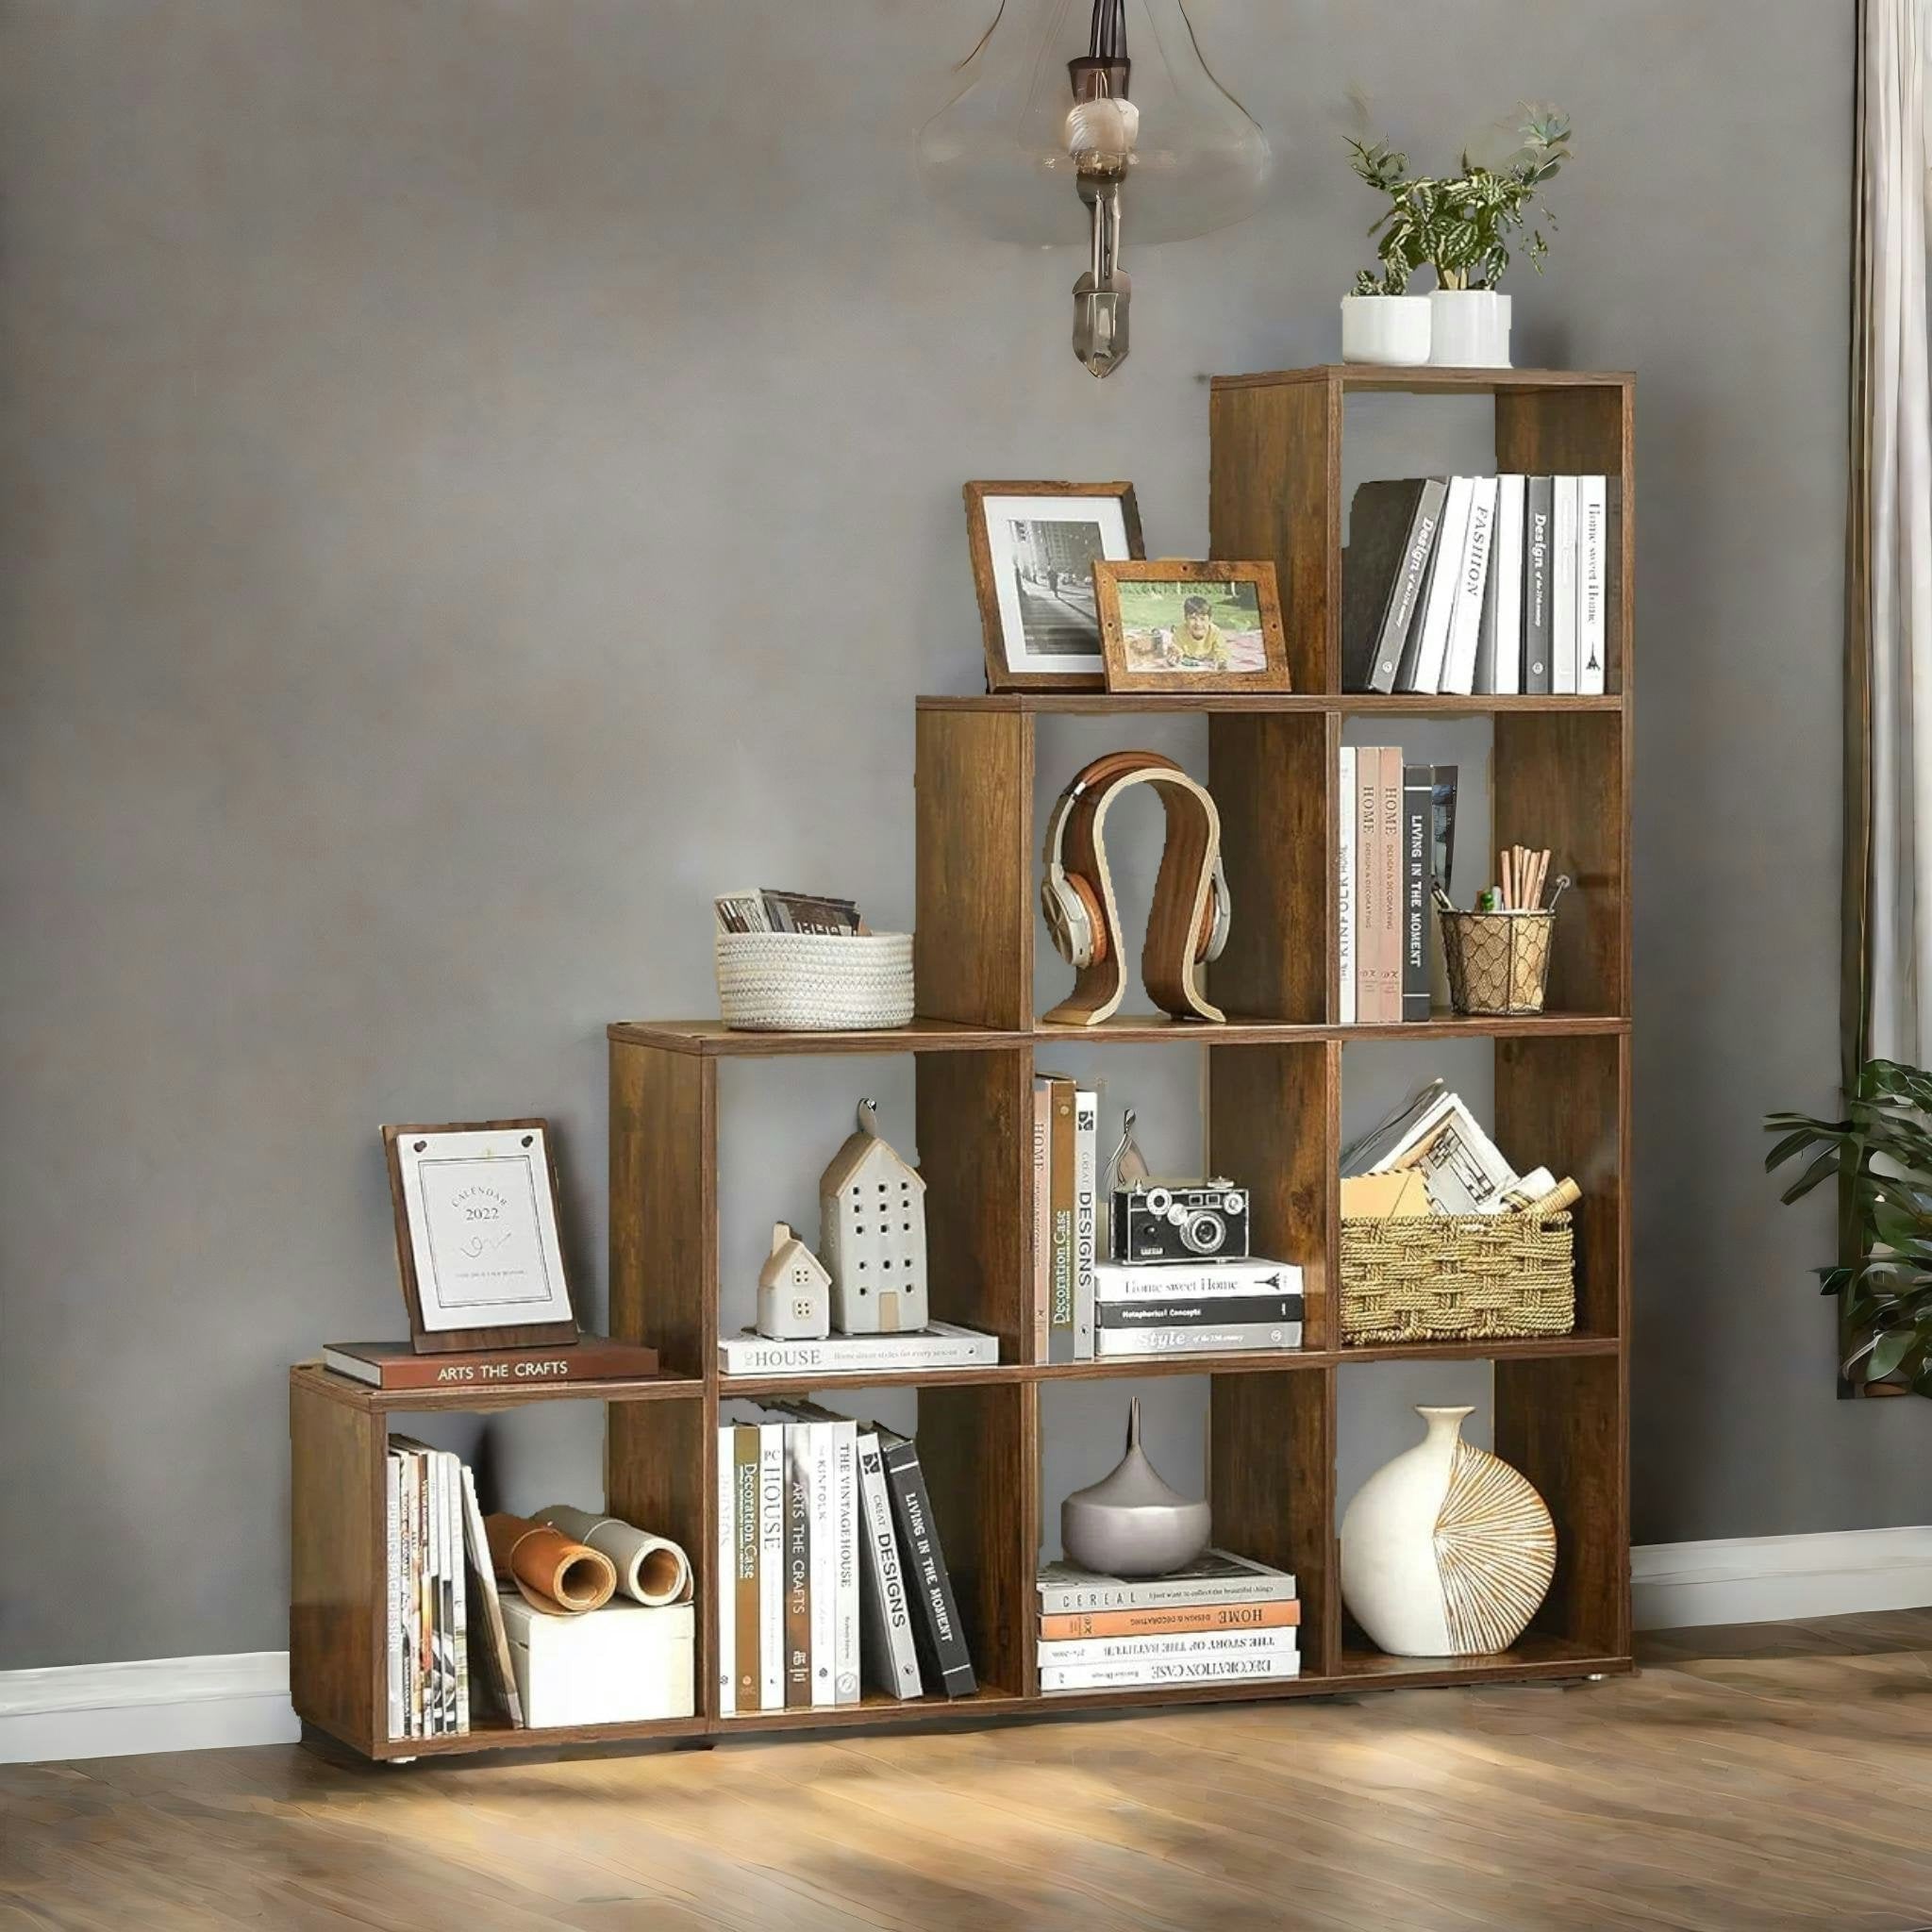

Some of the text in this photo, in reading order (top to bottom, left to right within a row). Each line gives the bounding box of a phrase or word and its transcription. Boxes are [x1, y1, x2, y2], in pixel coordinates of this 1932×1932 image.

[1409, 516, 1434, 571] Design
[1467, 506, 1489, 596] FASHION
[1532, 513, 1547, 568] Design
[1363, 786, 1374, 834] HOME
[1385, 788, 1397, 836] HOME
[1410, 815, 1424, 968] LIVING IN THE MOMENT
[452, 1187, 508, 1208] CALENDAR
[466, 1208, 500, 1221] 2022
[1078, 1191, 1092, 1288] DESIGNS
[1054, 1210, 1067, 1324] Decoration Case
[438, 1360, 568, 1381] ARTS THE CRAFTS
[756, 1349, 823, 1367] HOUSE
[840, 1443, 850, 1473] THE
[743, 1463, 757, 1578] Decoration Case
[763, 1468, 781, 1550] HOUSE
[792, 1482, 806, 1614] ARTS THE CRAFTS
[905, 1492, 953, 1642] LIVING IN THE MOMENT
[877, 1533, 906, 1627] DESIGNS
[1063, 1591, 1136, 1607] CEREAL
[1130, 1615, 1177, 1626] DECORATING
[1185, 1613, 1211, 1622] DESIGN
[1219, 1609, 1263, 1624] HOME
[1162, 1641, 1185, 1653] THE
[1189, 1641, 1206, 1652] OF
[1209, 1639, 1248, 1650] STORY
[1250, 1637, 1274, 1647] THE
[1151, 1664, 1185, 1680] CASE
[1187, 1659, 1271, 1677] DECORATION
